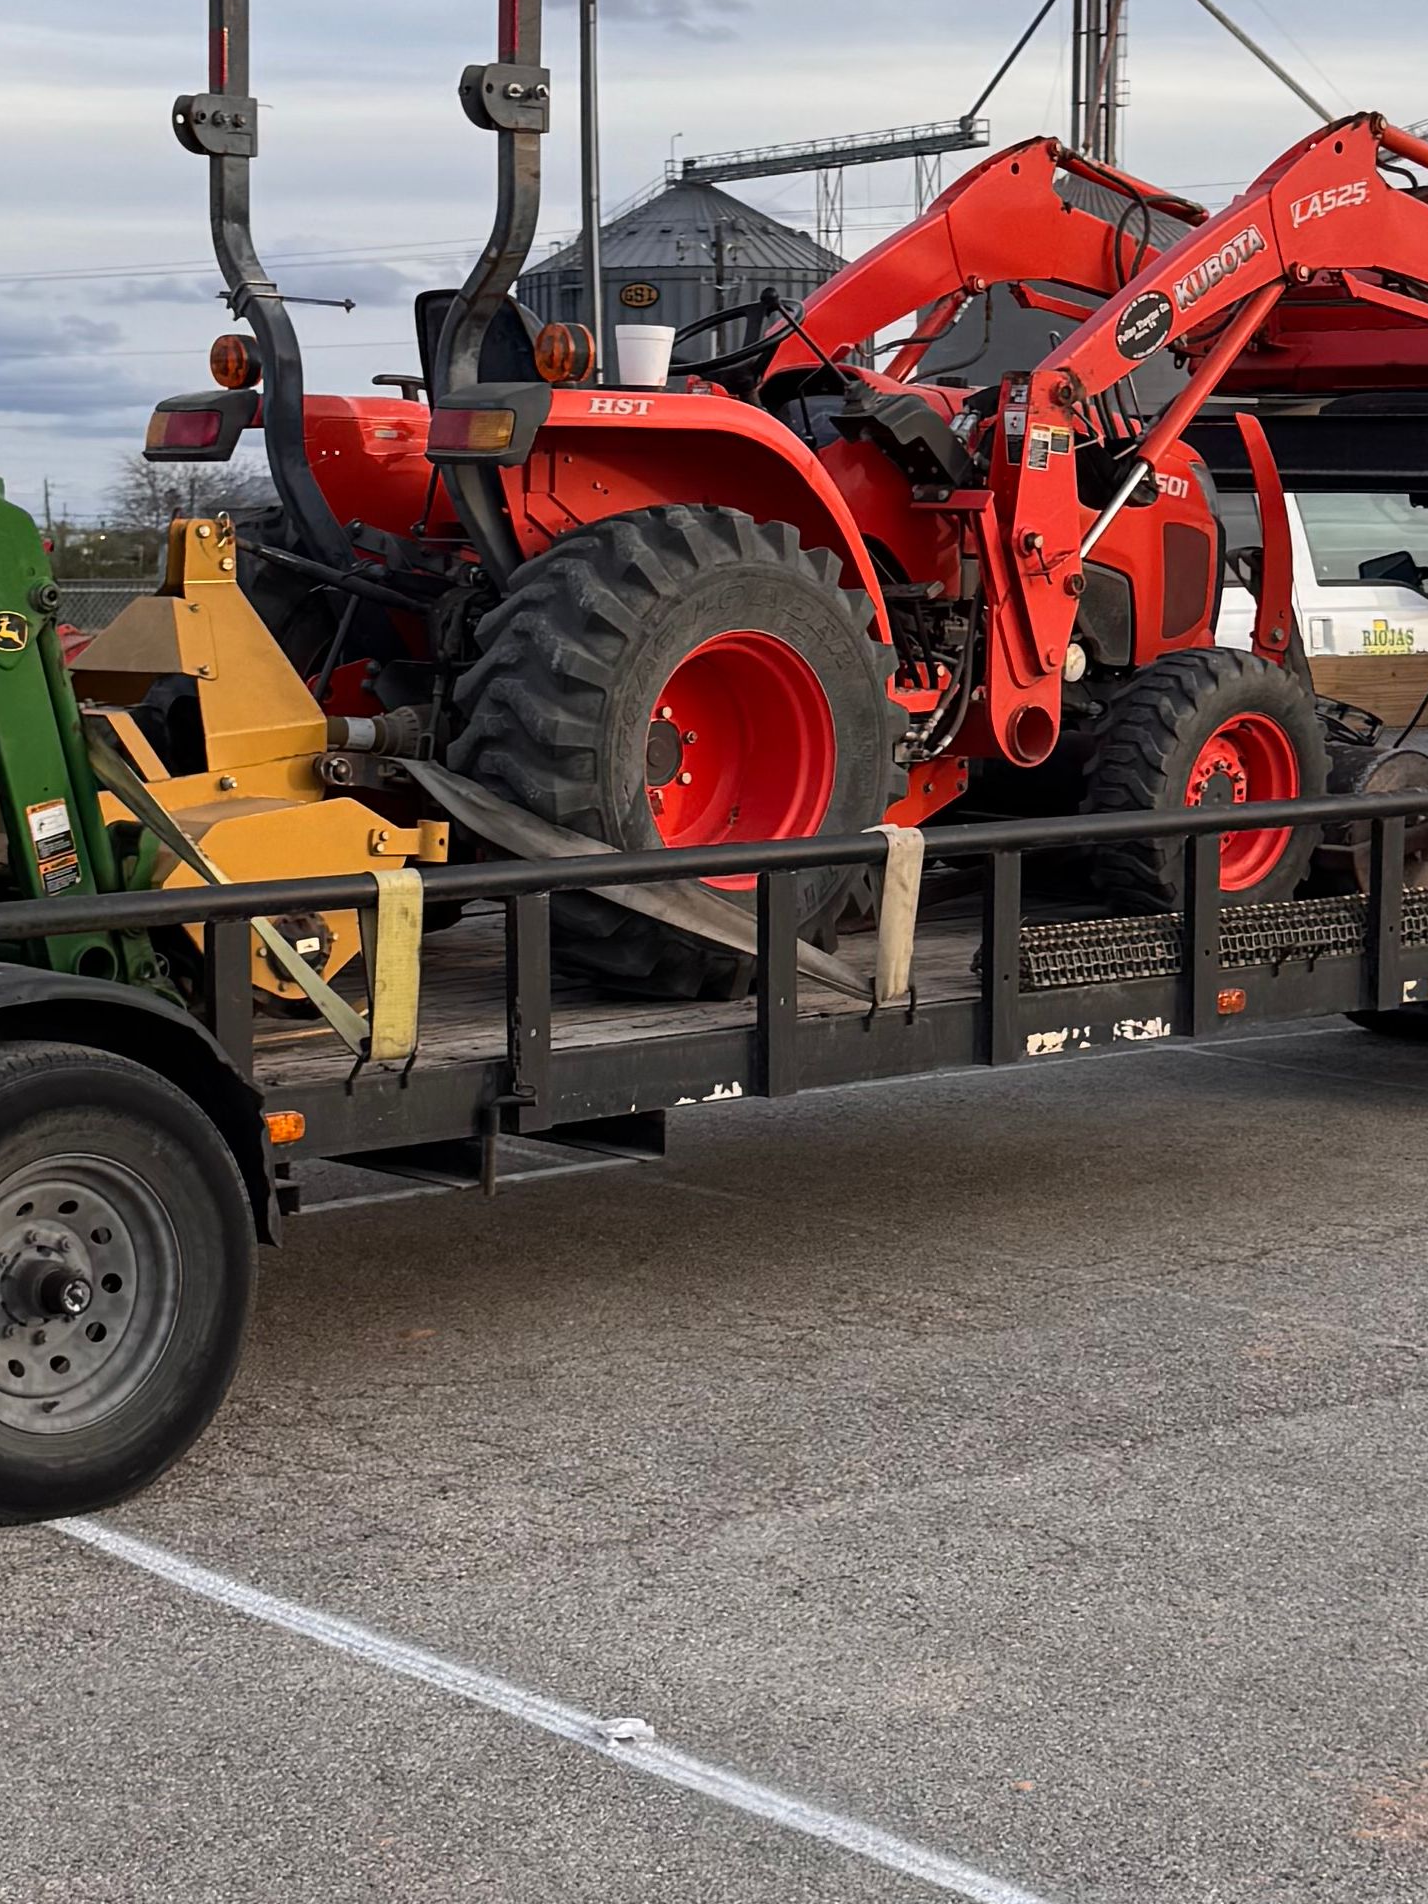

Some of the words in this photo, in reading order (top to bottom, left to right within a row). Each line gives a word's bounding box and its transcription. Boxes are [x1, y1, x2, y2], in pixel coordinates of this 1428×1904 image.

[1291, 181, 1369, 228] LA525
[1174, 225, 1265, 311] KUBOTA
[624, 286, 656, 303] GSI
[588, 397, 655, 416] HST
[1362, 628, 1414, 646] RIOJAS
